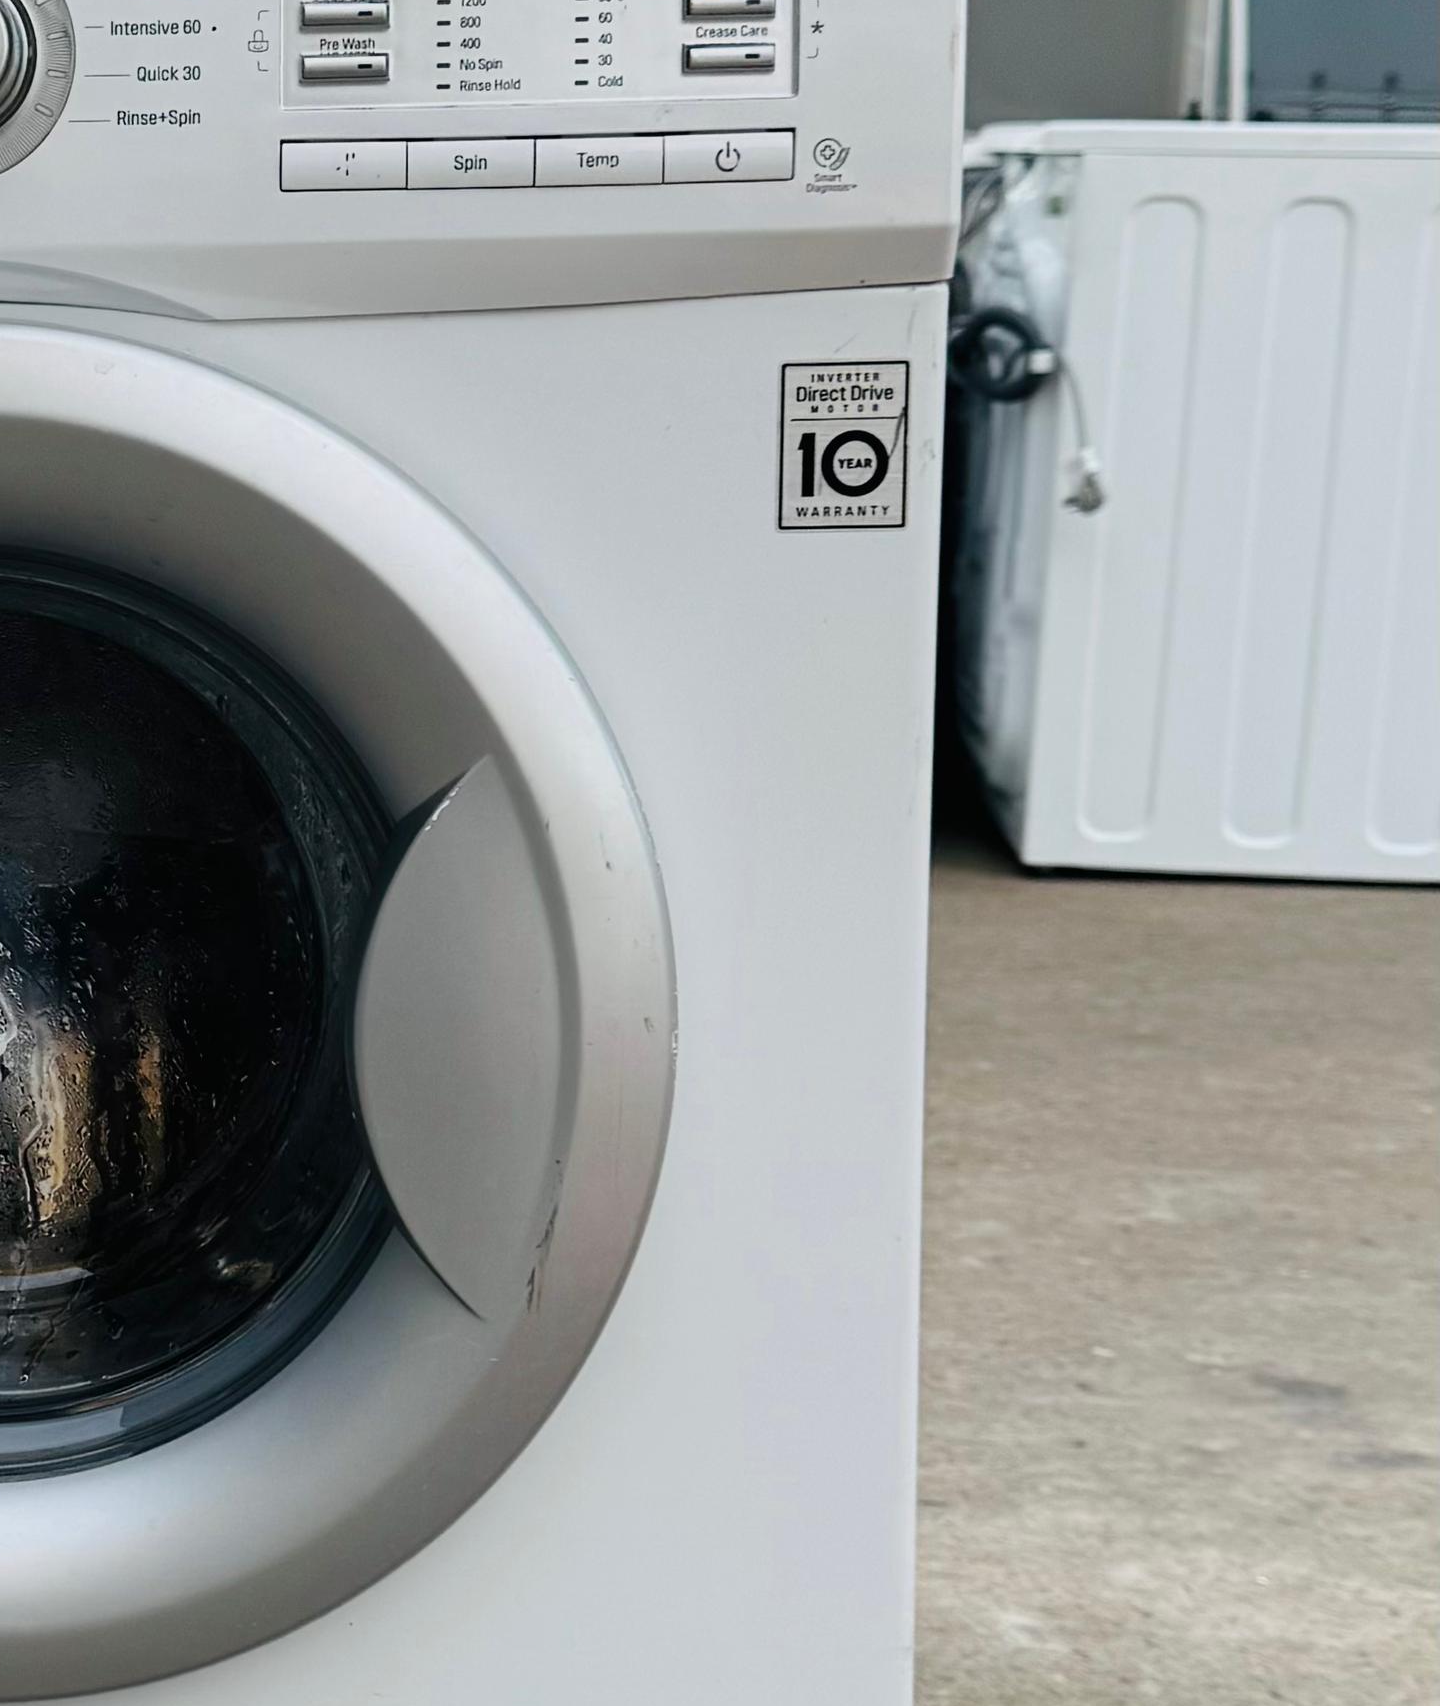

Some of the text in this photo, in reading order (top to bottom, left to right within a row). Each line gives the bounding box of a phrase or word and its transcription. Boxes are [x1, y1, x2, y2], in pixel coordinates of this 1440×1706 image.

[460, 16, 481, 28] 800
[598, 12, 613, 24] 60
[109, 19, 202, 36] Intensive 60
[695, 25, 769, 38] Crease Care
[320, 37, 376, 50] Pre Wash
[460, 38, 481, 50] 400
[598, 33, 613, 45] 40
[460, 58, 503, 72] No Spin
[598, 54, 613, 66] 30
[136, 66, 202, 84] Quick 30
[598, 75, 624, 88] Cold
[459, 77, 522, 92] Rinse Hold
[116, 108, 202, 129] Rinse+Spin
[453, 153, 488, 174] Spin
[576, 150, 620, 170] Temp
[810, 371, 881, 384] INVERTER
[795, 384, 895, 403] Direct Drive
[797, 429, 890, 498] 10
[837, 457, 873, 470] YEAR
[795, 504, 891, 518] WARRANTY
